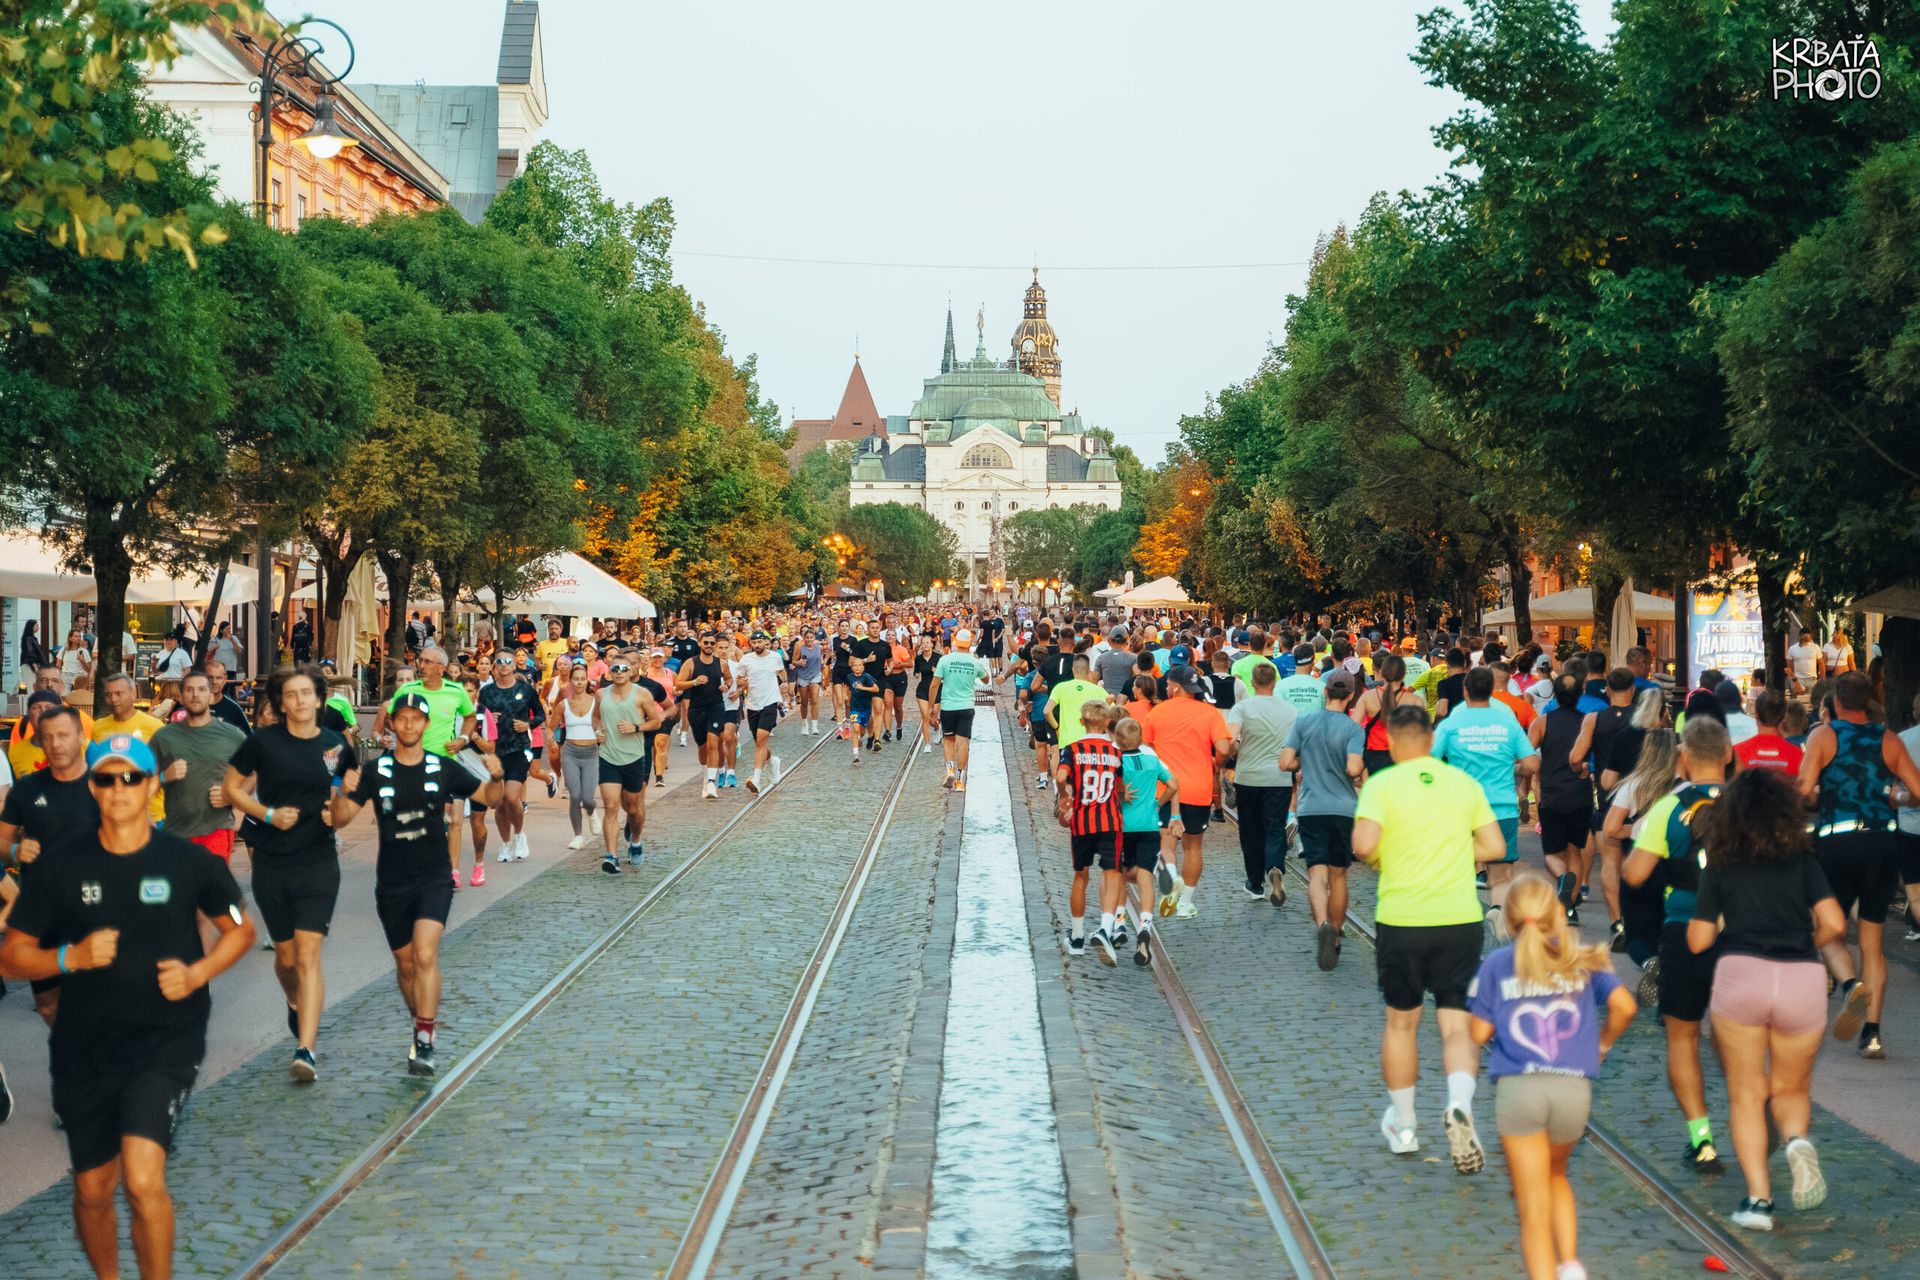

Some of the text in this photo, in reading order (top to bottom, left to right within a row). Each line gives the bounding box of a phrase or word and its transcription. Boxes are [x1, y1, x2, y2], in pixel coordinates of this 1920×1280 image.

[1700, 635, 1764, 655] HANDBAL
[1081, 770, 1114, 805] 80
[81, 882, 102, 905] 33
